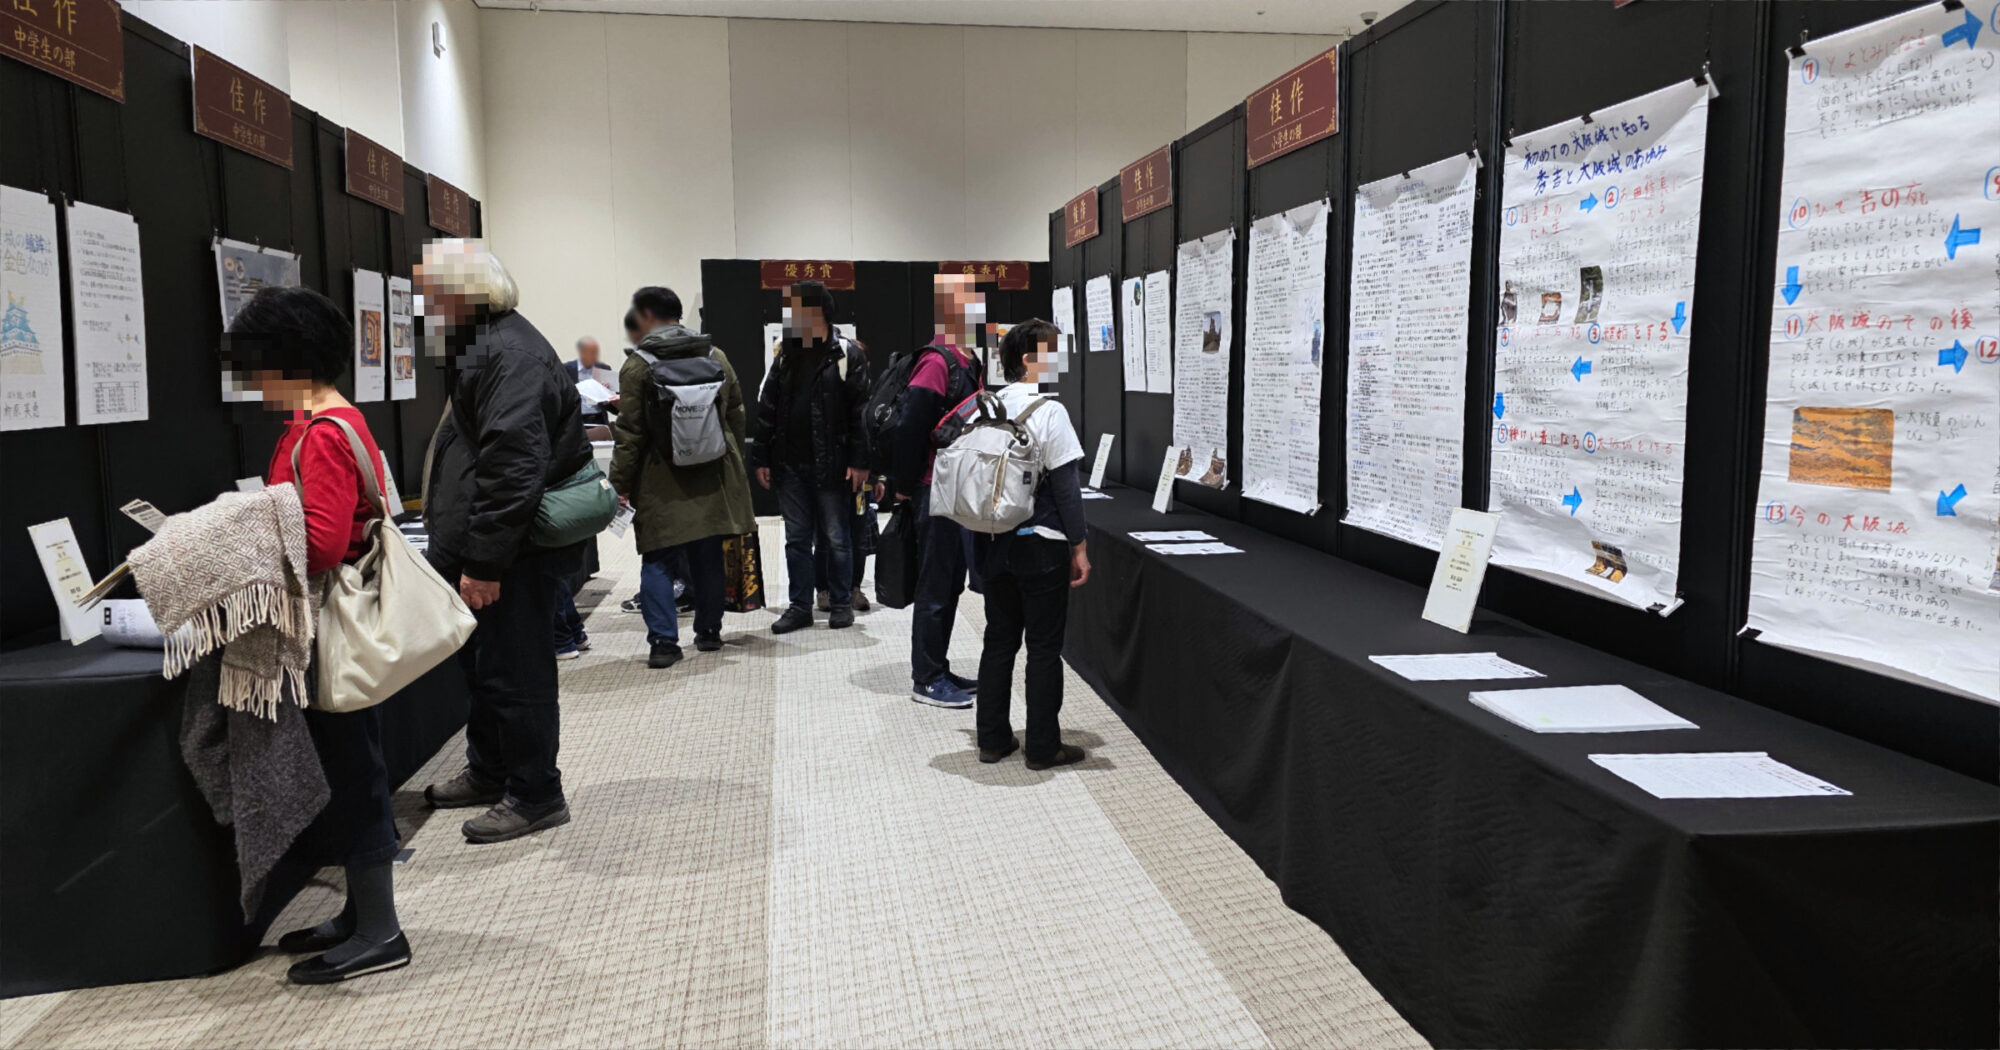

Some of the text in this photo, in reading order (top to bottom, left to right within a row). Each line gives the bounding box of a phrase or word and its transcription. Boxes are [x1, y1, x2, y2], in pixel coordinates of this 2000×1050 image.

[14, 24, 76, 71] 中学生の部
[230, 77, 266, 124] 佳作
[1270, 77, 1304, 125] 佳作
[1523, 114, 1650, 171] 初めての大阪城で知る
[1534, 145, 1668, 197] 秀吉と大阪城のあゆみ
[784, 263, 833, 279] 優秀賞
[1805, 307, 1976, 334] 大阪城のその後
[1789, 504, 1911, 535] 今の大阪城
